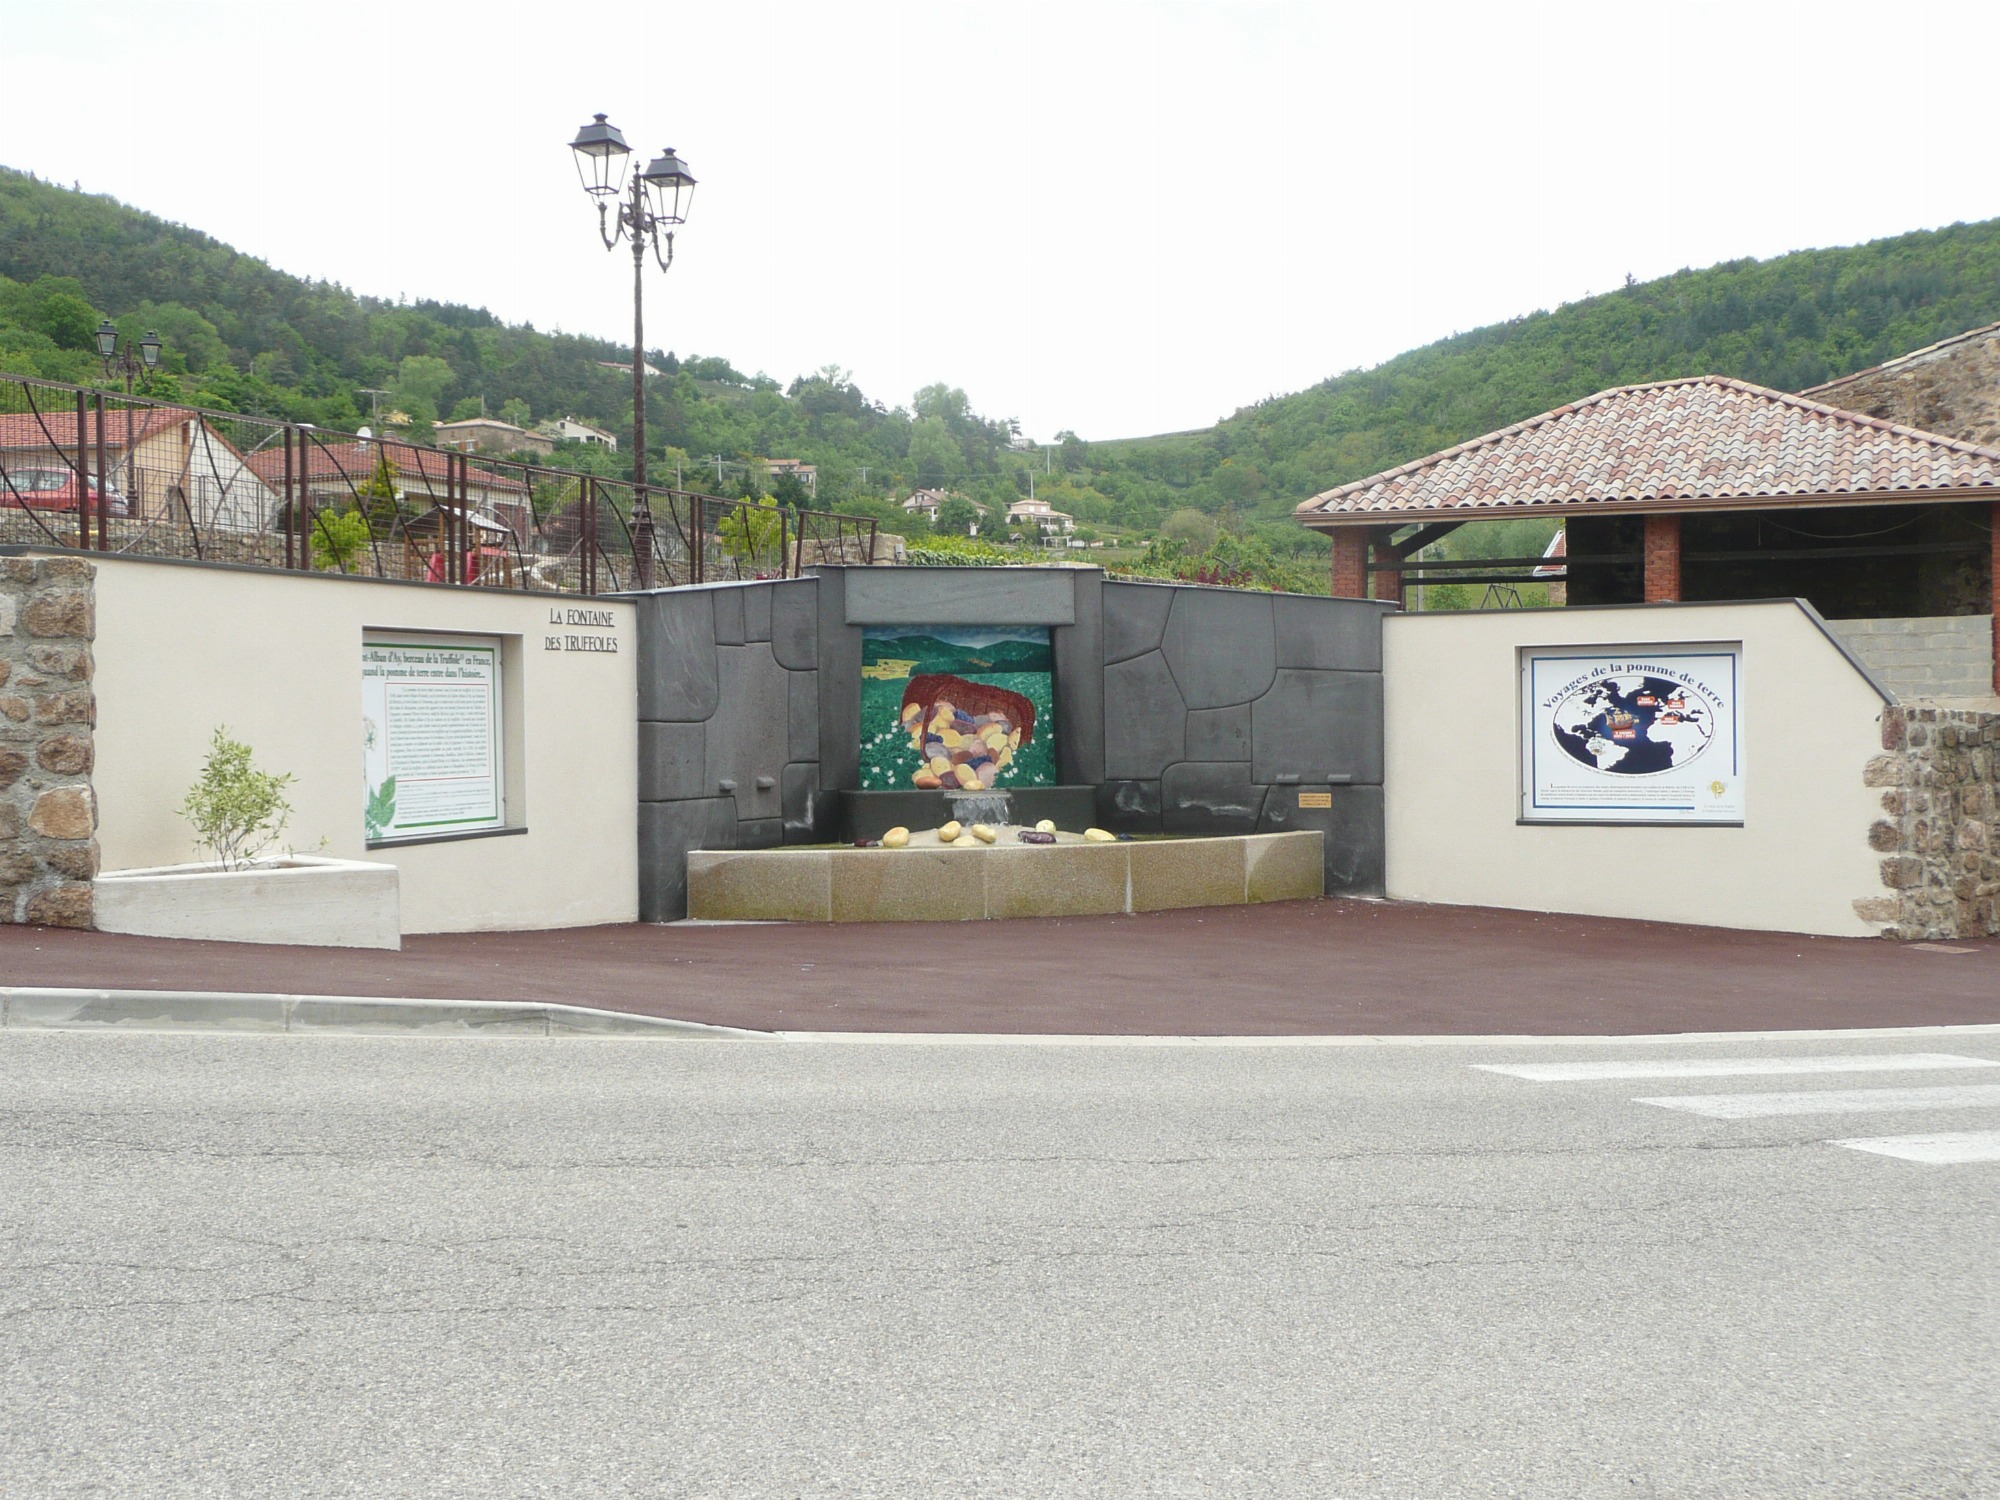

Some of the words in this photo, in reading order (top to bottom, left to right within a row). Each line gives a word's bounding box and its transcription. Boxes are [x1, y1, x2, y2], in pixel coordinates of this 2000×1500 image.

[549, 607, 563, 624] LA
[566, 608, 615, 627] FONTAINE
[544, 636, 561, 650] DES
[564, 635, 618, 653] TRUFFOLES
[425, 652, 432, 664] de
[1542, 674, 1589, 709] Voyages
[1591, 667, 1607, 678] de
[1609, 663, 1622, 673] la
[1626, 663, 1676, 678] pomme
[1679, 672, 1695, 685] de
[1697, 681, 1725, 710] terre
